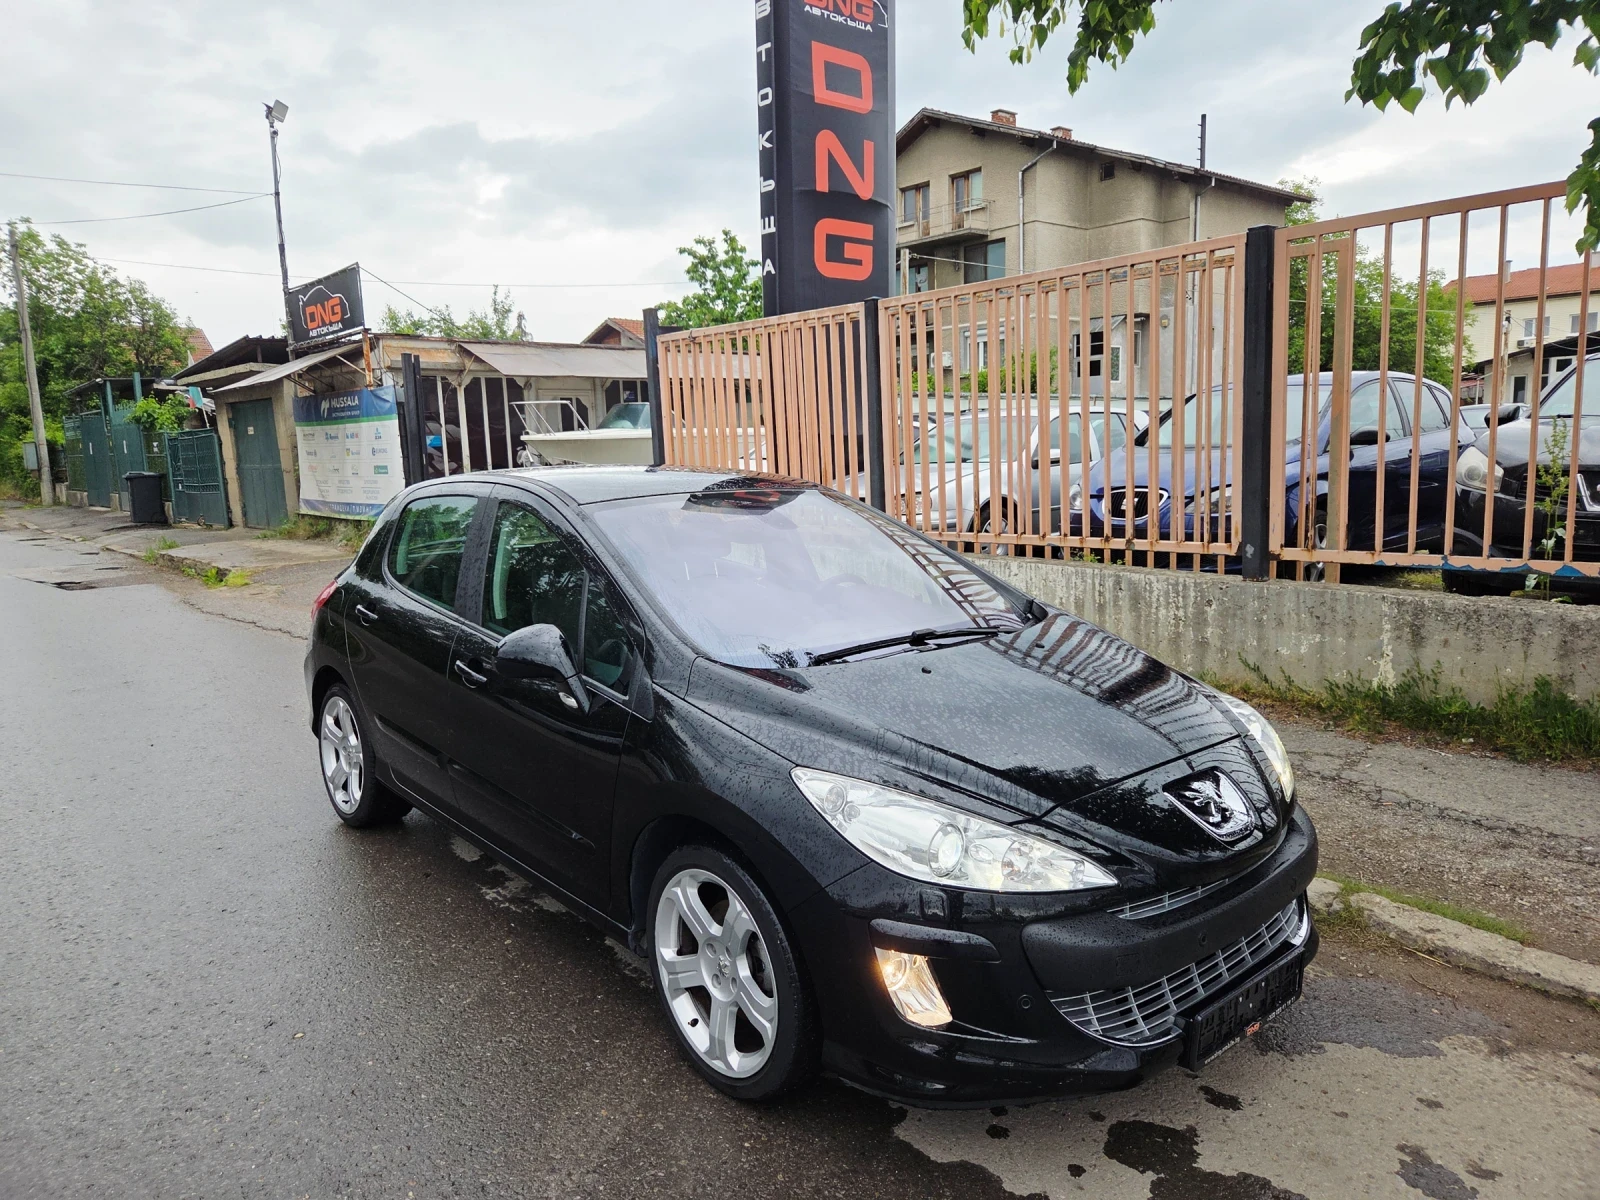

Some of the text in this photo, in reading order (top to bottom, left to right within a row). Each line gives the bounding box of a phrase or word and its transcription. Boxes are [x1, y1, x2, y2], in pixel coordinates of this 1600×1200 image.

[804, 5, 873, 32] АВТОКЪША
[811, 40, 875, 281] DNG
[305, 297, 342, 330] DNG
[309, 321, 343, 337] АВТОКЪША
[330, 395, 359, 408] MUSSALA
